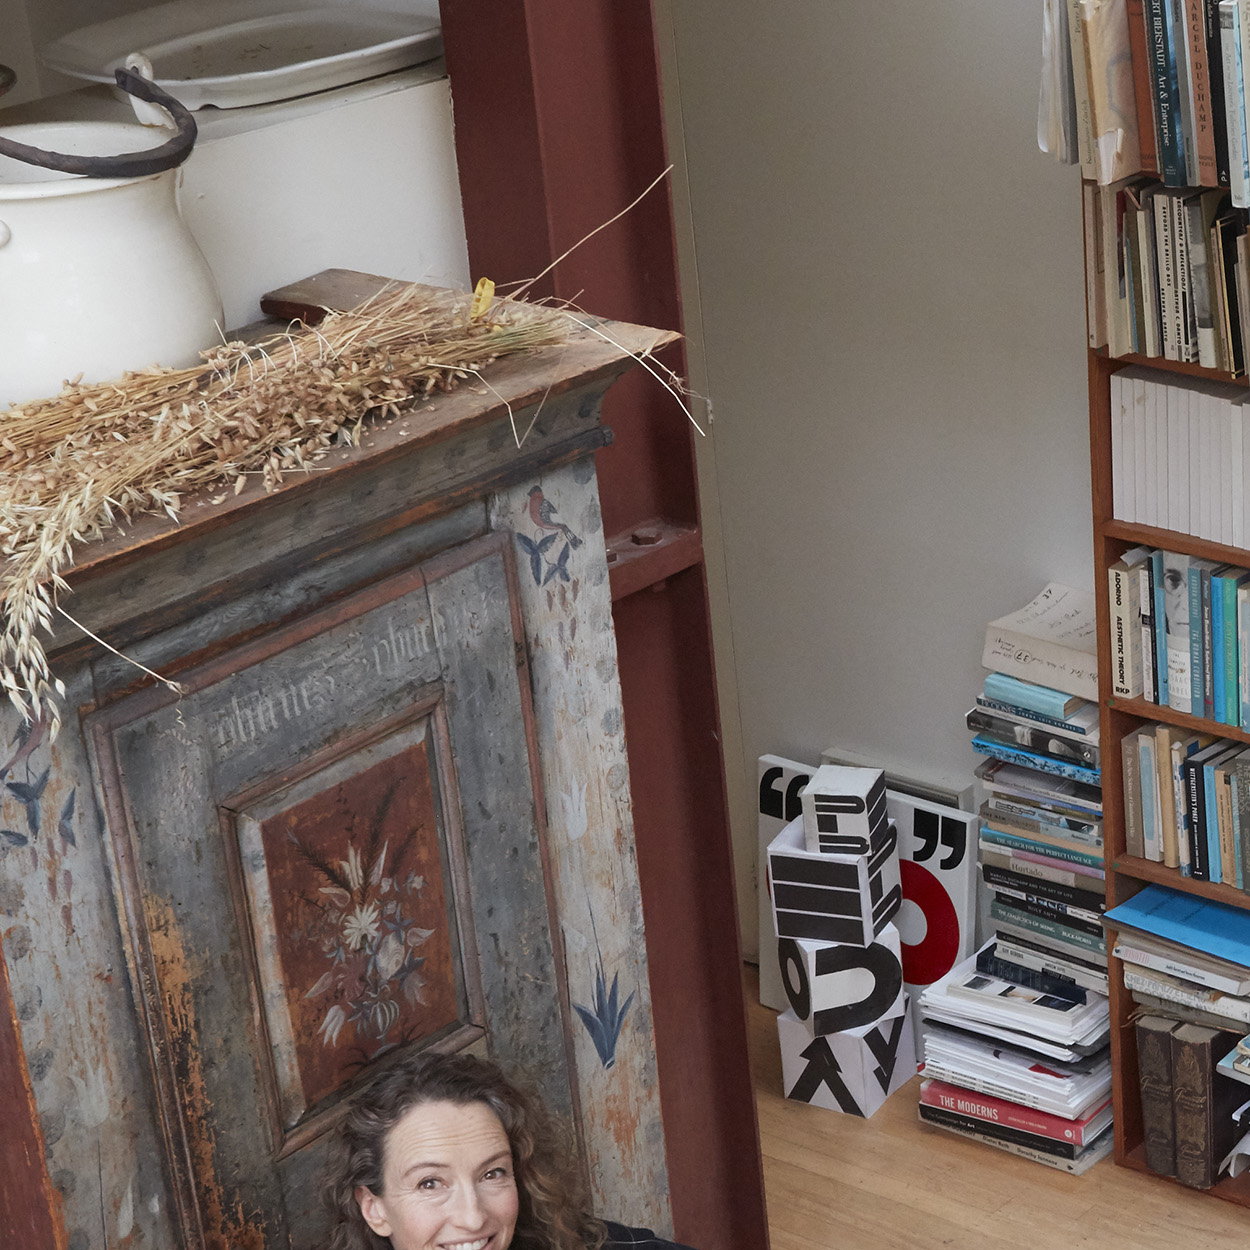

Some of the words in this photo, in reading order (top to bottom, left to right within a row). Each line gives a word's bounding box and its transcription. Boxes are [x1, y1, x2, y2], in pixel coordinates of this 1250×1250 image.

[1152, 17, 1164, 66] BIERSTADT
[1157, 75, 1167, 88] Art
[1195, 62, 1207, 132] DUCHAMP
[1159, 102, 1172, 146] Enterprise
[1113, 571, 1122, 606] ADORNO
[1115, 615, 1125, 655] AESTHETIC
[1117, 655, 1126, 685] THEORY
[1011, 862, 1043, 877] Hurtado
[939, 1095, 955, 1108] THE
[957, 1098, 998, 1120] MODERNS
